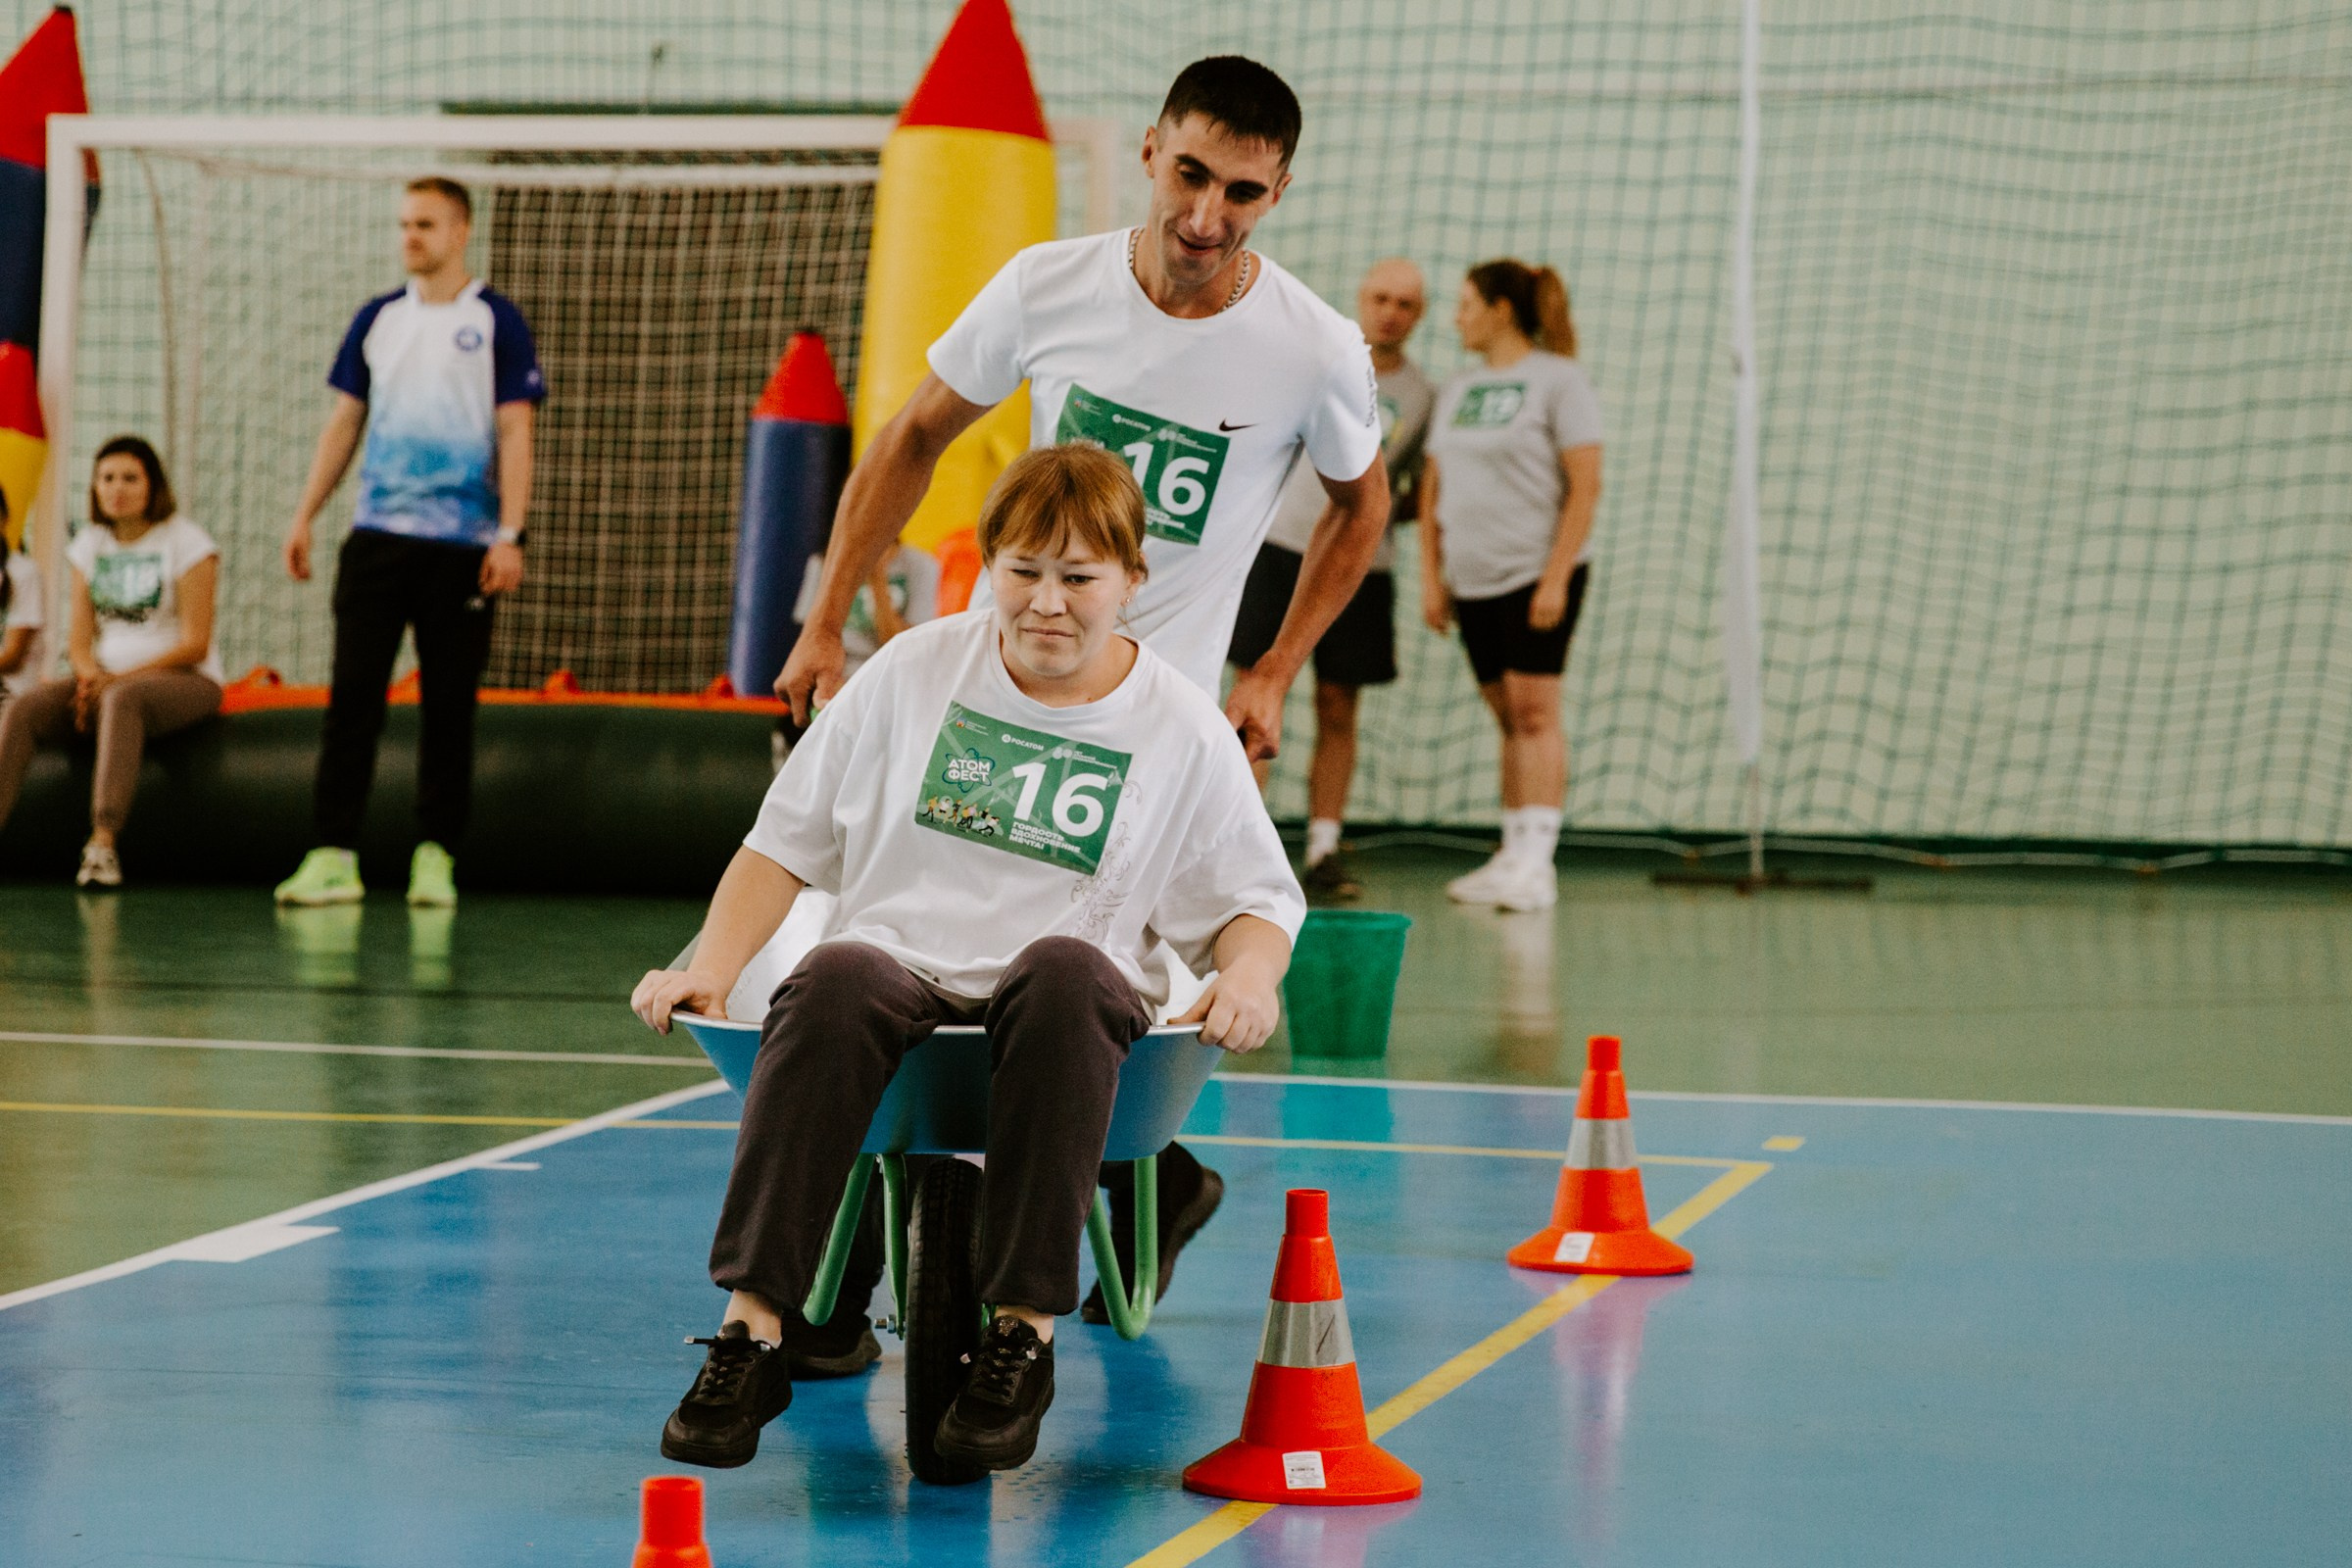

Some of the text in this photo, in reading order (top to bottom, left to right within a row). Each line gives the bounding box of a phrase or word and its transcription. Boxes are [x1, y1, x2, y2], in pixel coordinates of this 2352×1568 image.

[1123, 441, 1210, 516] 16
[1010, 737, 1045, 751] РОСАТОМ
[948, 759, 991, 772] АТОМ
[948, 768, 990, 782] ФЕСТ
[1012, 761, 1108, 837] 16
[1012, 821, 1065, 841] ГОРДОСТЬ
[1008, 834, 1045, 850] МЕЧТА!
[1010, 828, 1081, 853] ВДОХНОВЕНИЕ
